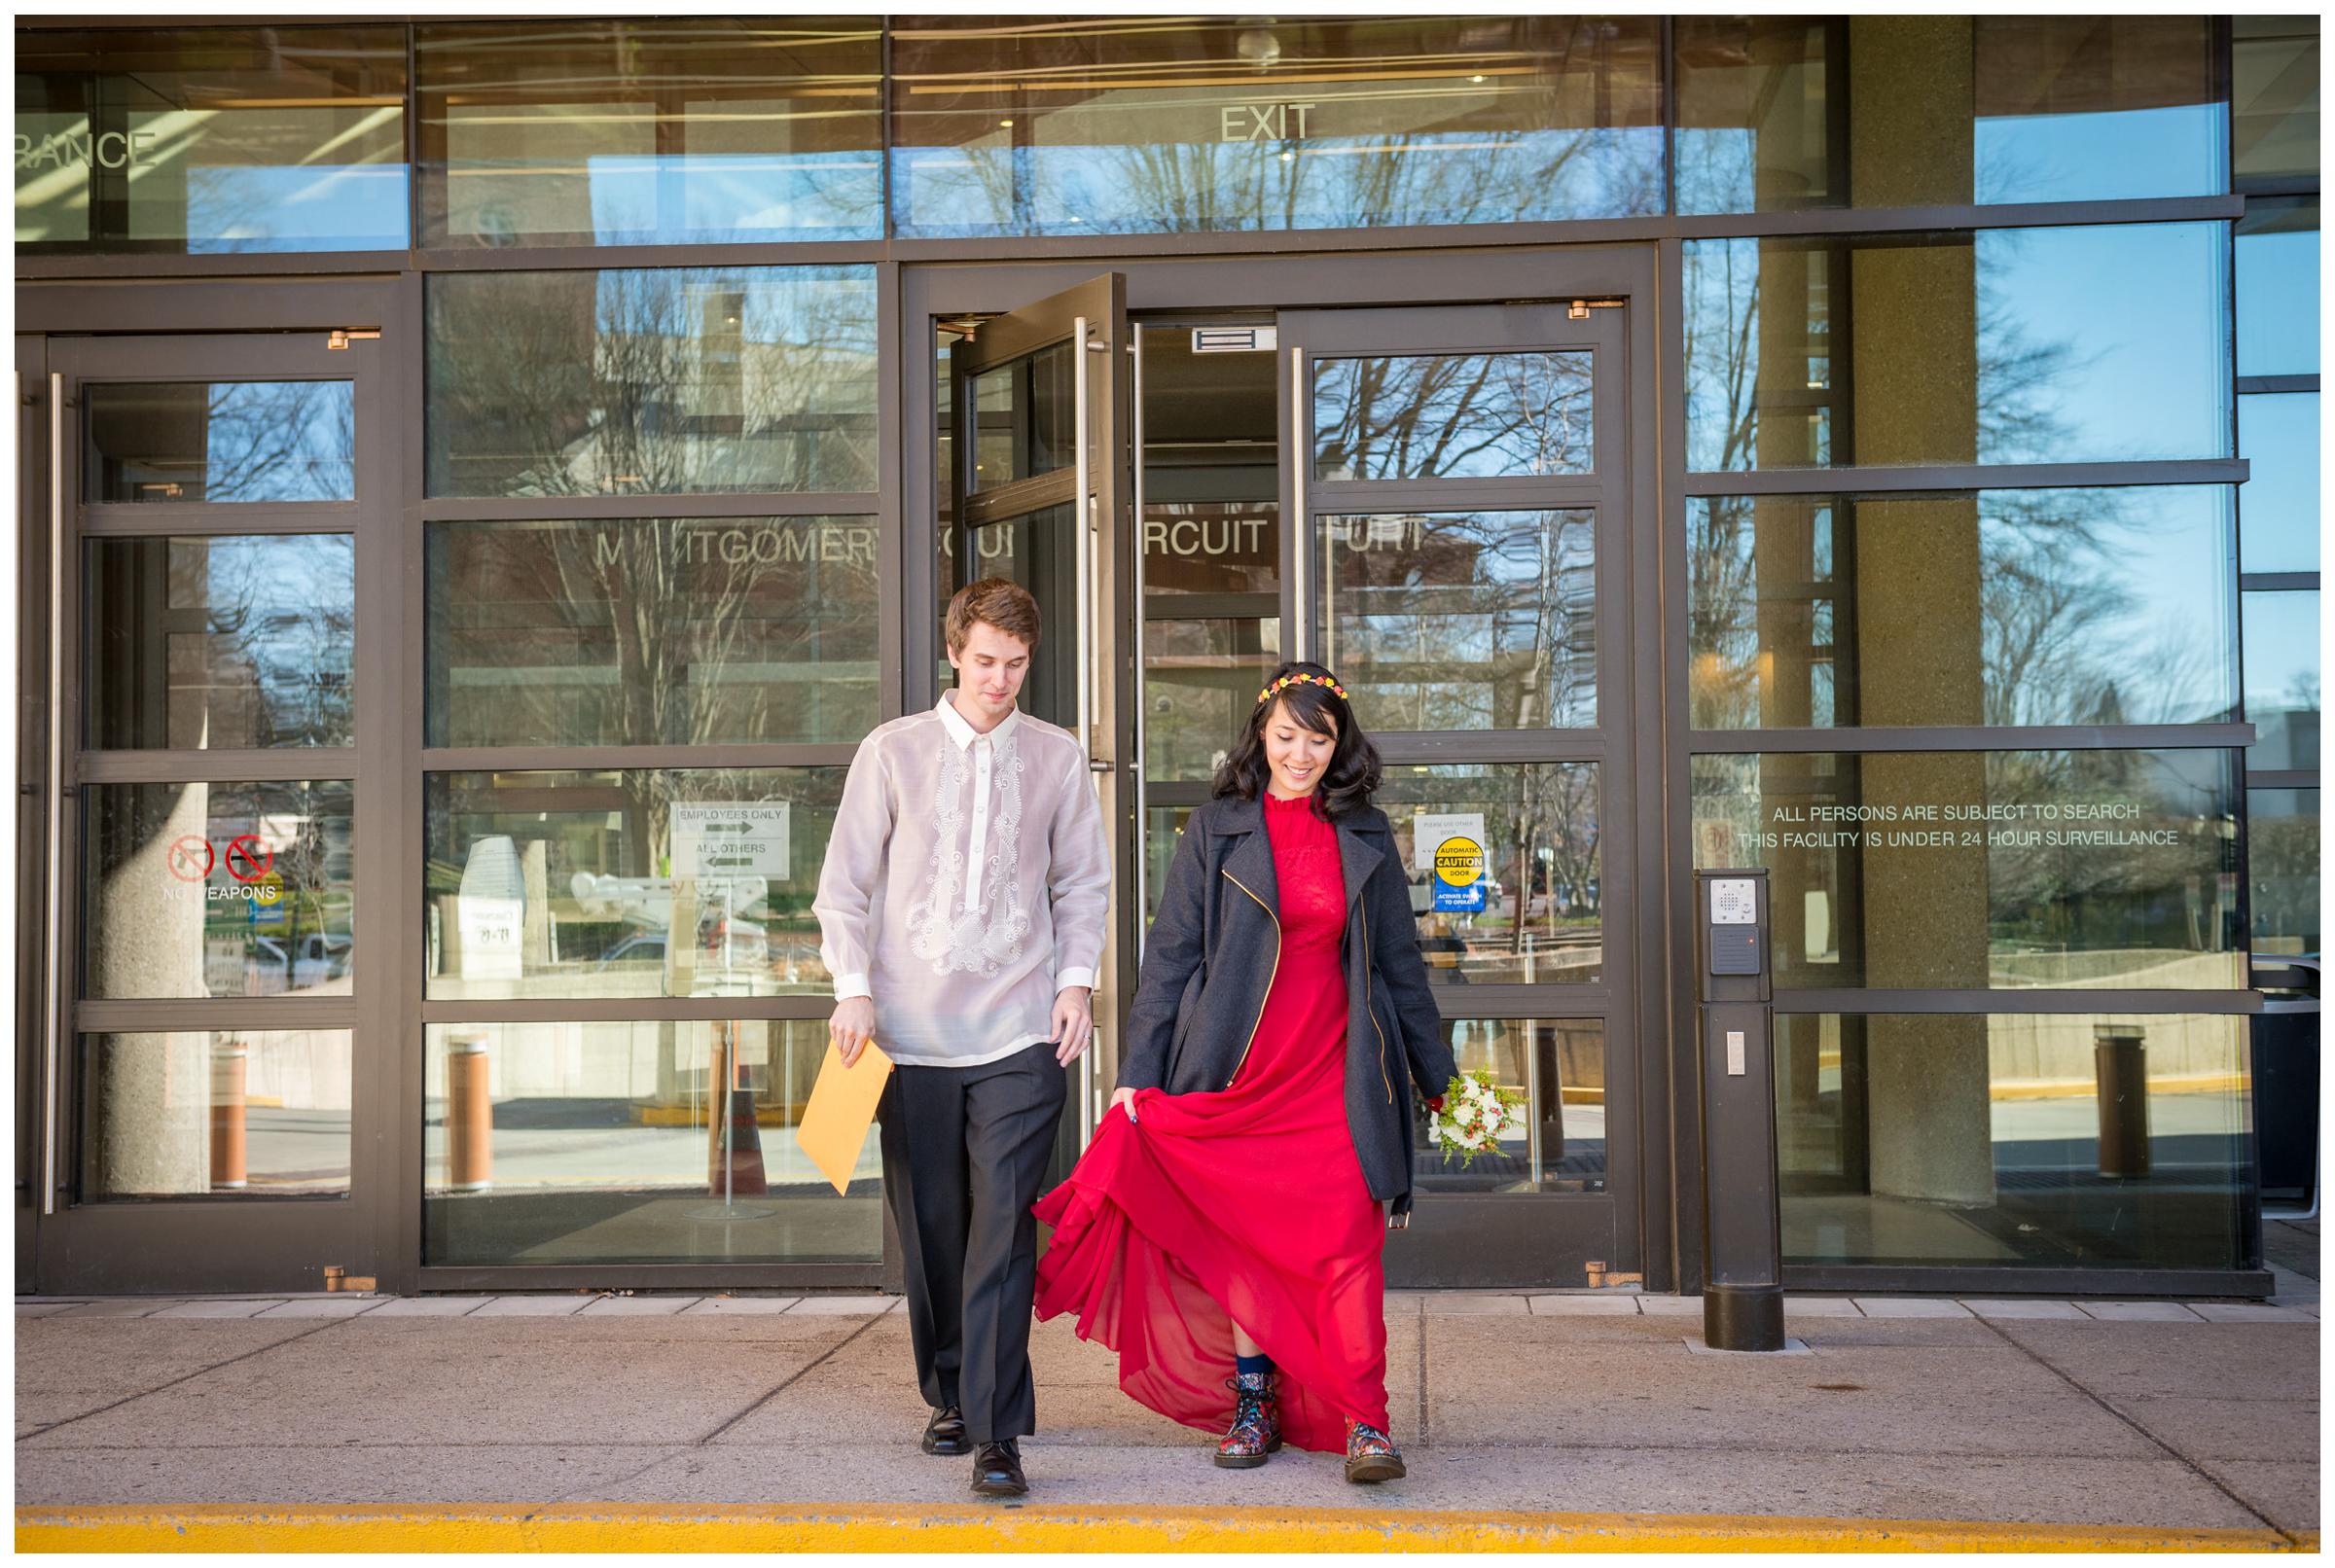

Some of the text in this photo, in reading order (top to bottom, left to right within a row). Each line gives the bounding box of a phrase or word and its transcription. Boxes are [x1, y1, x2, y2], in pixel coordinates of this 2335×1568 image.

[1221, 103, 1316, 142] EXIT
[15, 131, 157, 168] RANCE
[596, 528, 880, 565] MTGOMER
[680, 810, 781, 820] EMPLOYEES ONLY
[1773, 803, 2140, 822] ALL PERSONS ARE SUBJECT TO SEARCH
[697, 843, 766, 853] ALL OTHERS
[1738, 830, 2178, 848] THIS FACILITY IS UNDER 24 HOUR SURVEILLANCE
[1436, 858, 1483, 867] CAUTION
